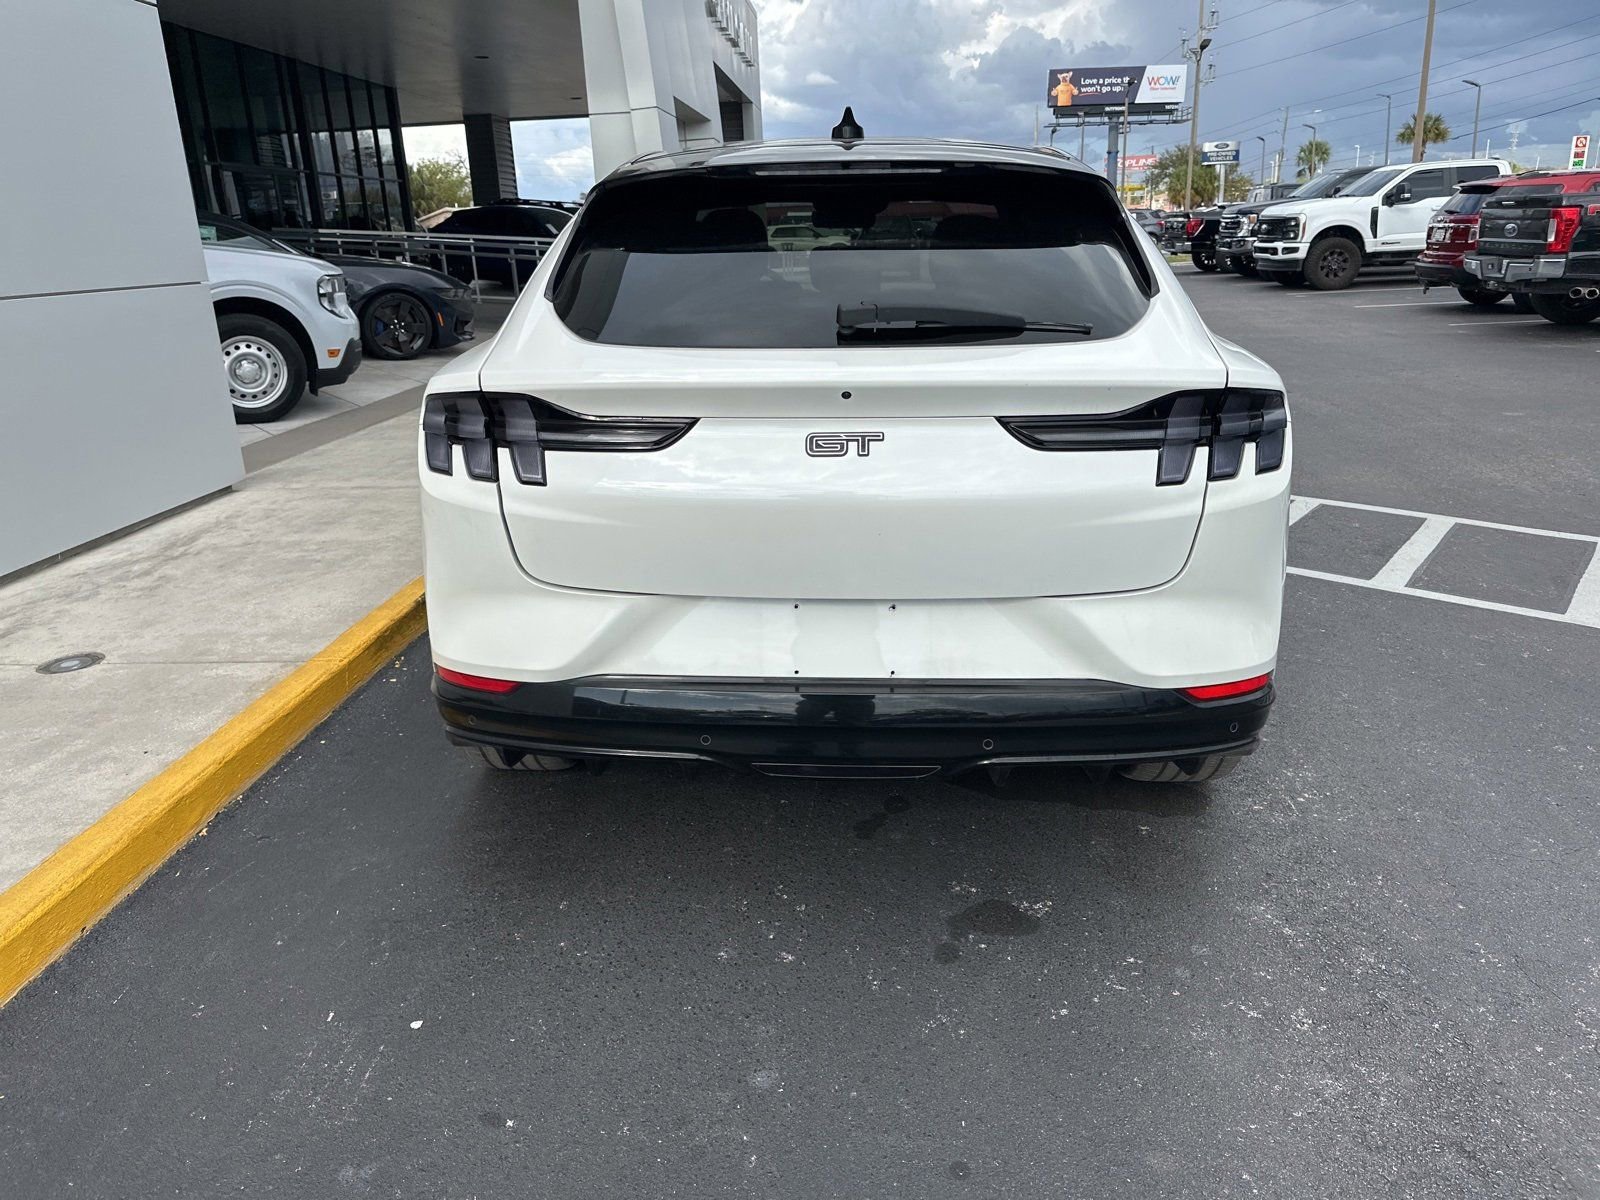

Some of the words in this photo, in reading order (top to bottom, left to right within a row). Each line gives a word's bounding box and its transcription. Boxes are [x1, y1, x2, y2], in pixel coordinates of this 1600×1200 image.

[1081, 77, 1098, 85] Love
[1104, 76, 1122, 85] price
[1147, 75, 1180, 86] WOW!
[805, 431, 884, 457] GT
